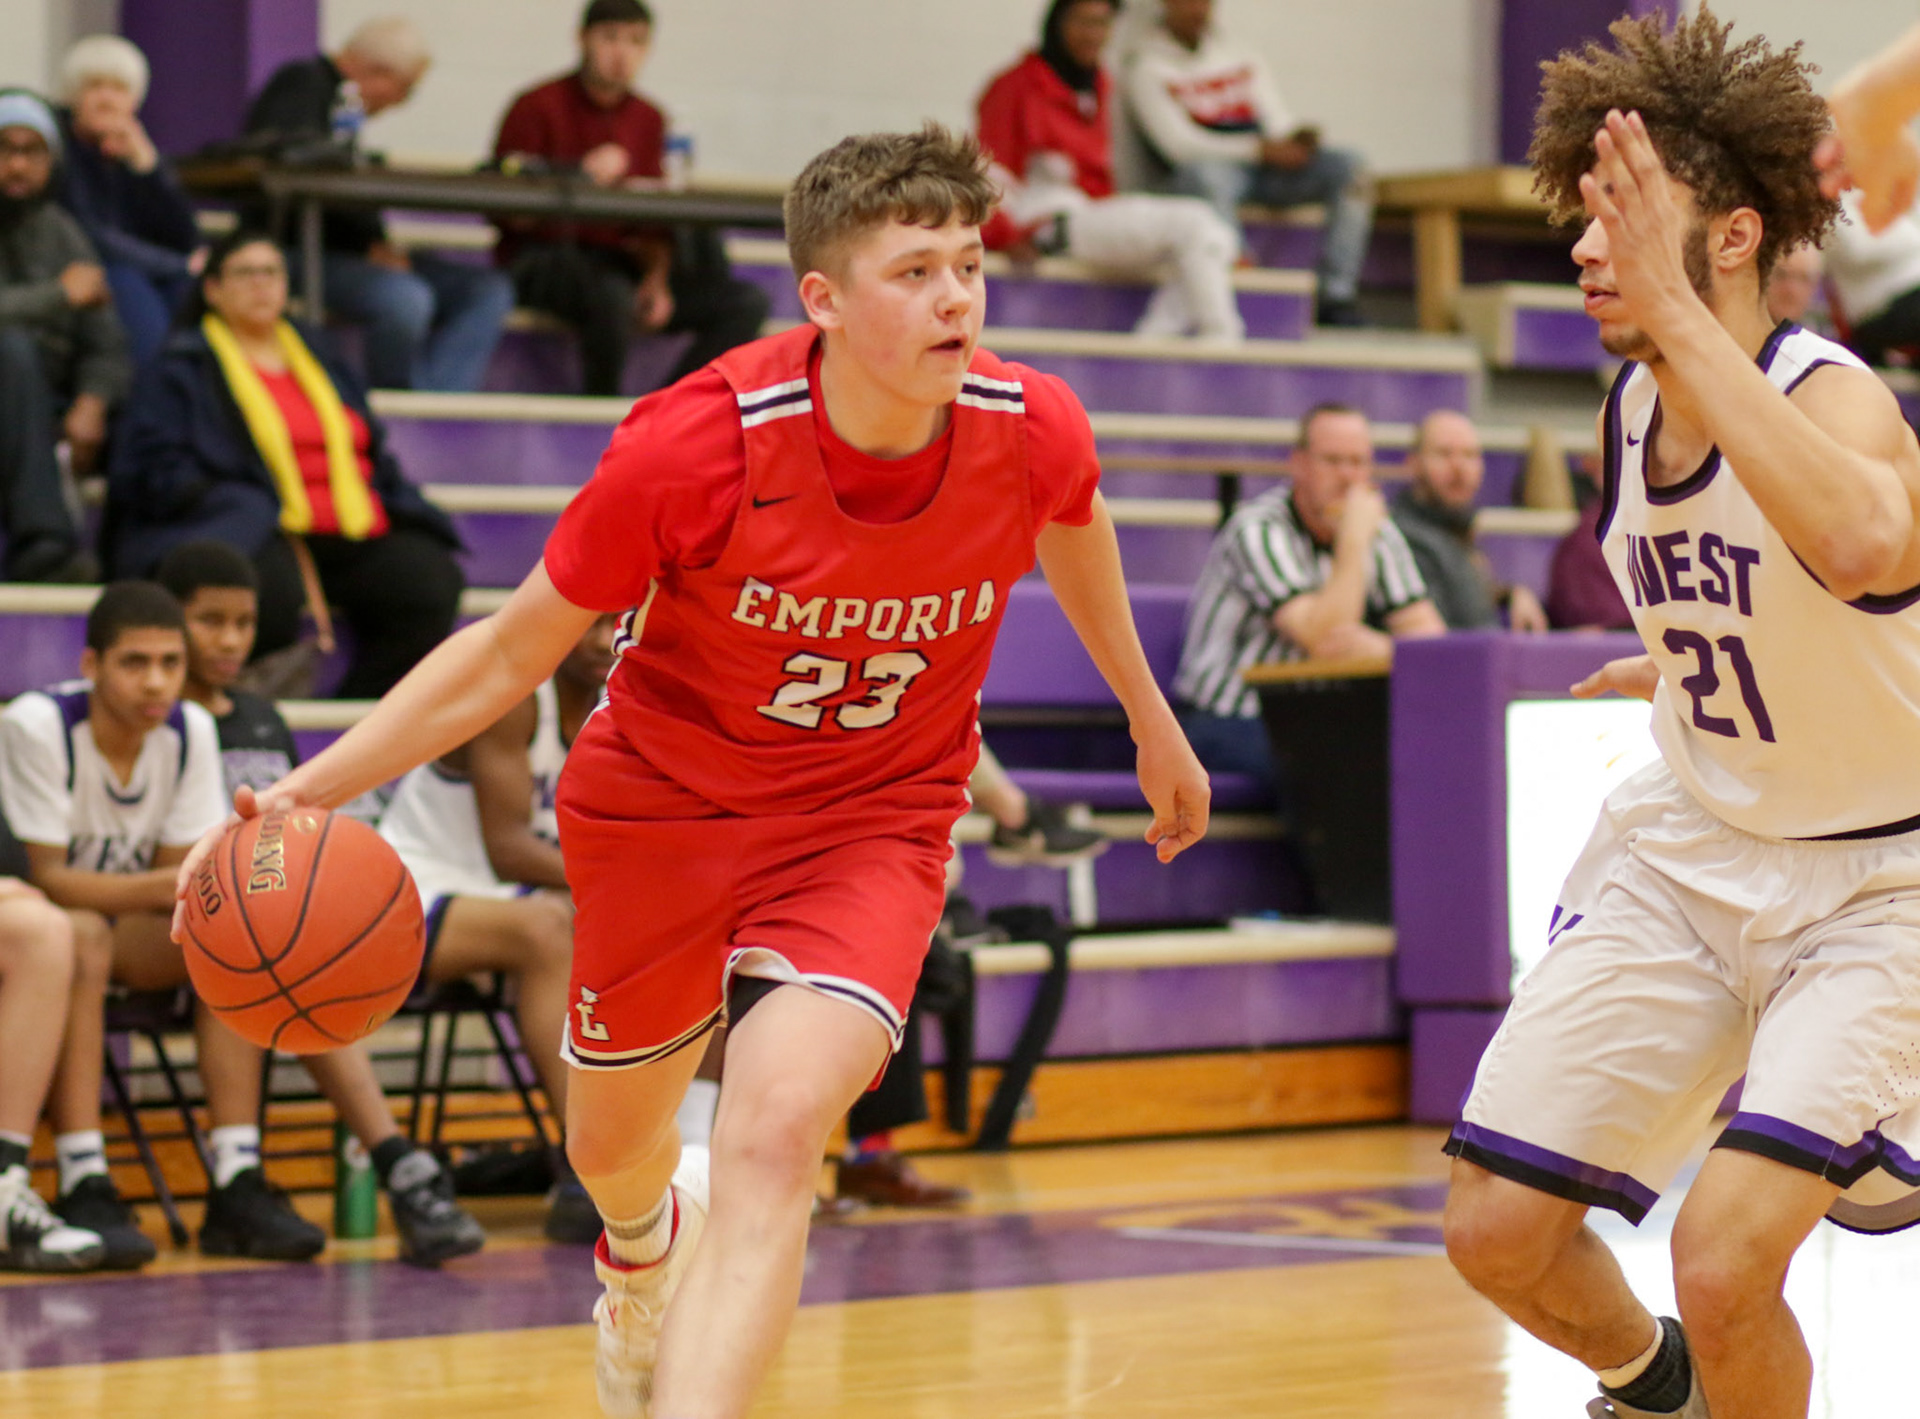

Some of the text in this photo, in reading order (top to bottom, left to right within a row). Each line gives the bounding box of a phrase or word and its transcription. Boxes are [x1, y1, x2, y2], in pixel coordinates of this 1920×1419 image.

[731, 575, 996, 643] EMPORIA
[1626, 529, 1761, 618] WEST
[755, 649, 931, 731] 23
[1661, 627, 1778, 744] 21
